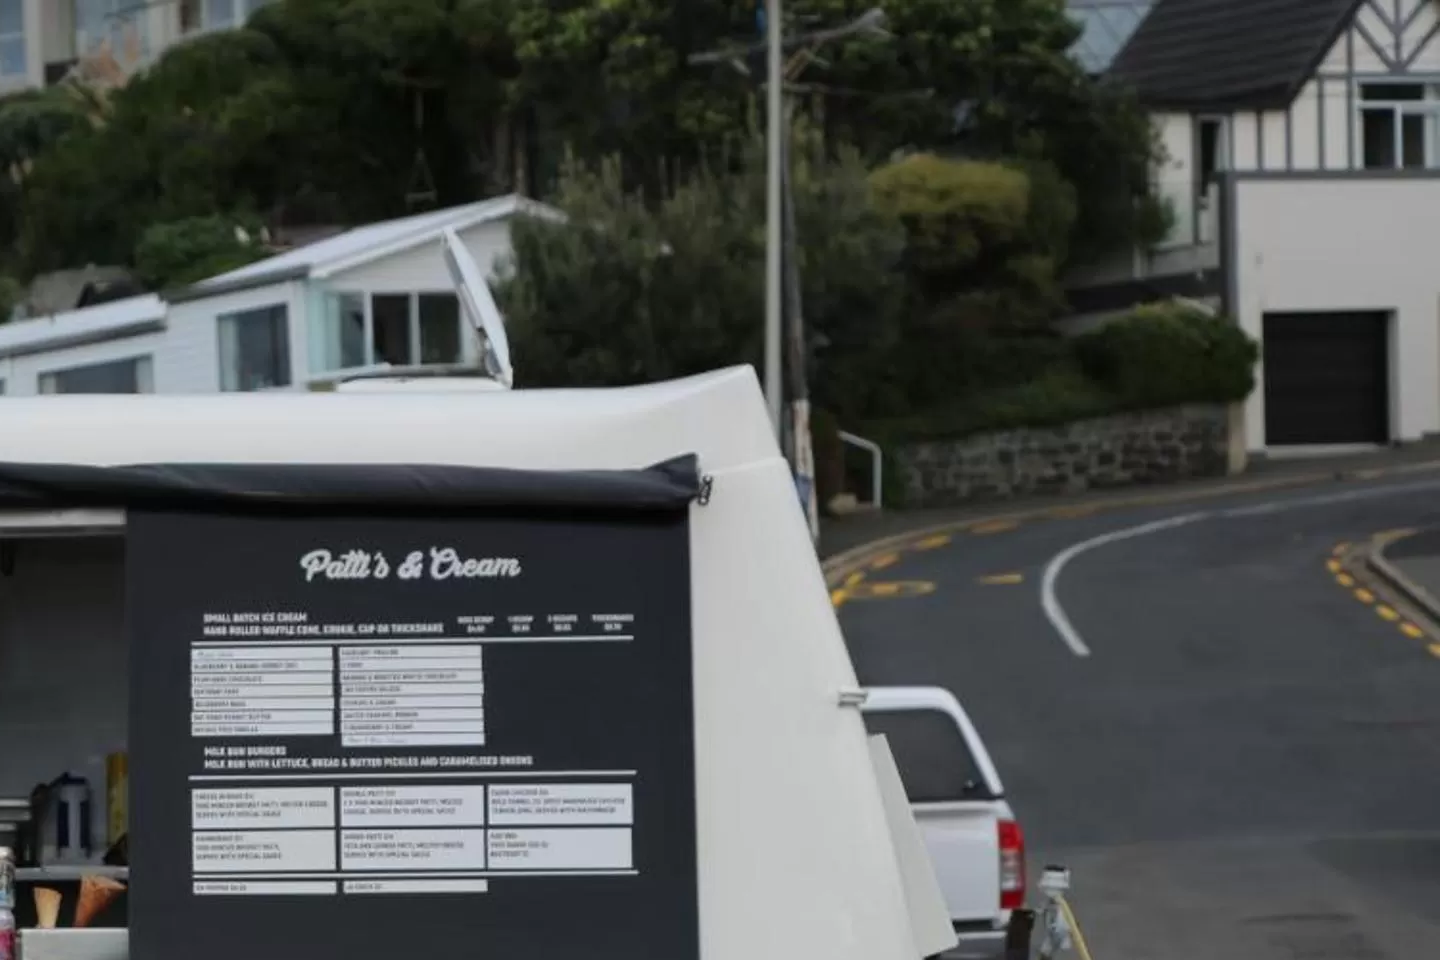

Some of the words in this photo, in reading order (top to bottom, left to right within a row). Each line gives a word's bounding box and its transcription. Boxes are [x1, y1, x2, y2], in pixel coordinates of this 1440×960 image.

[300, 548, 390, 582] Patti's
[396, 551, 424, 580] &
[430, 546, 522, 580] Cream
[203, 613, 232, 624] SMALL
[233, 613, 260, 624] BATCH
[262, 613, 276, 624] ICE
[277, 612, 307, 623] CREAM
[358, 623, 376, 634] CUP
[247, 758, 269, 769] WITH
[341, 758, 348, 767] &
[349, 757, 382, 767] BUTTER
[420, 756, 438, 767] AND
